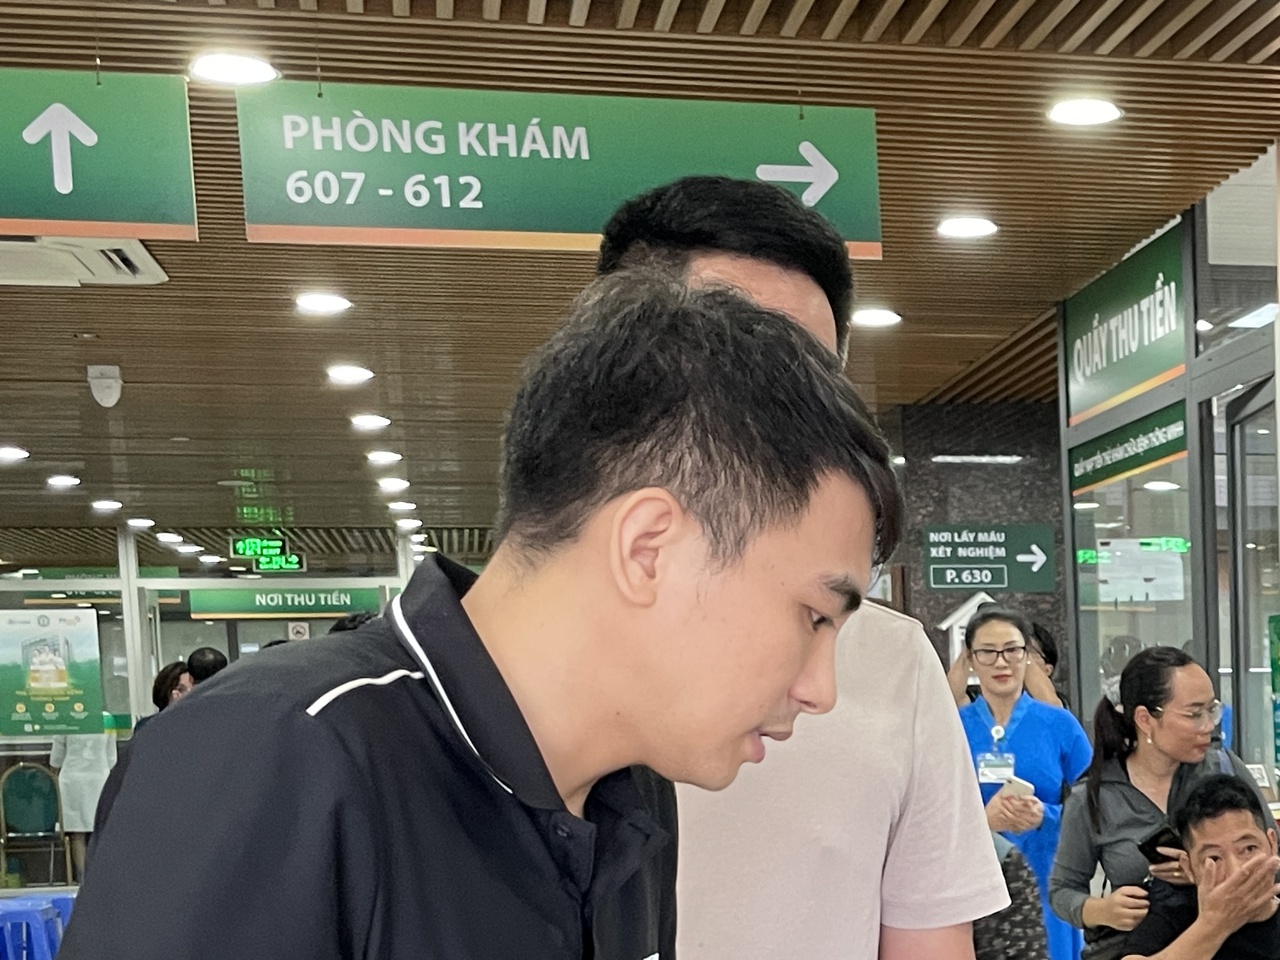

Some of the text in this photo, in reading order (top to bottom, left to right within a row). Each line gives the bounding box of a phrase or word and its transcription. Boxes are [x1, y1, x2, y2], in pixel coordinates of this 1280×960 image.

[283, 110, 590, 160] PHÒNG KHÁM
[286, 170, 483, 208] 607 - 612
[1109, 304, 1139, 362] THU
[1140, 272, 1176, 345] TIỀN
[929, 529, 1005, 542] NƠI LẤY MÁU
[930, 545, 1006, 559] XÉT NGHIỆM
[945, 569, 992, 583] P. 630
[255, 593, 283, 606] NƠI
[285, 593, 315, 606] THU
